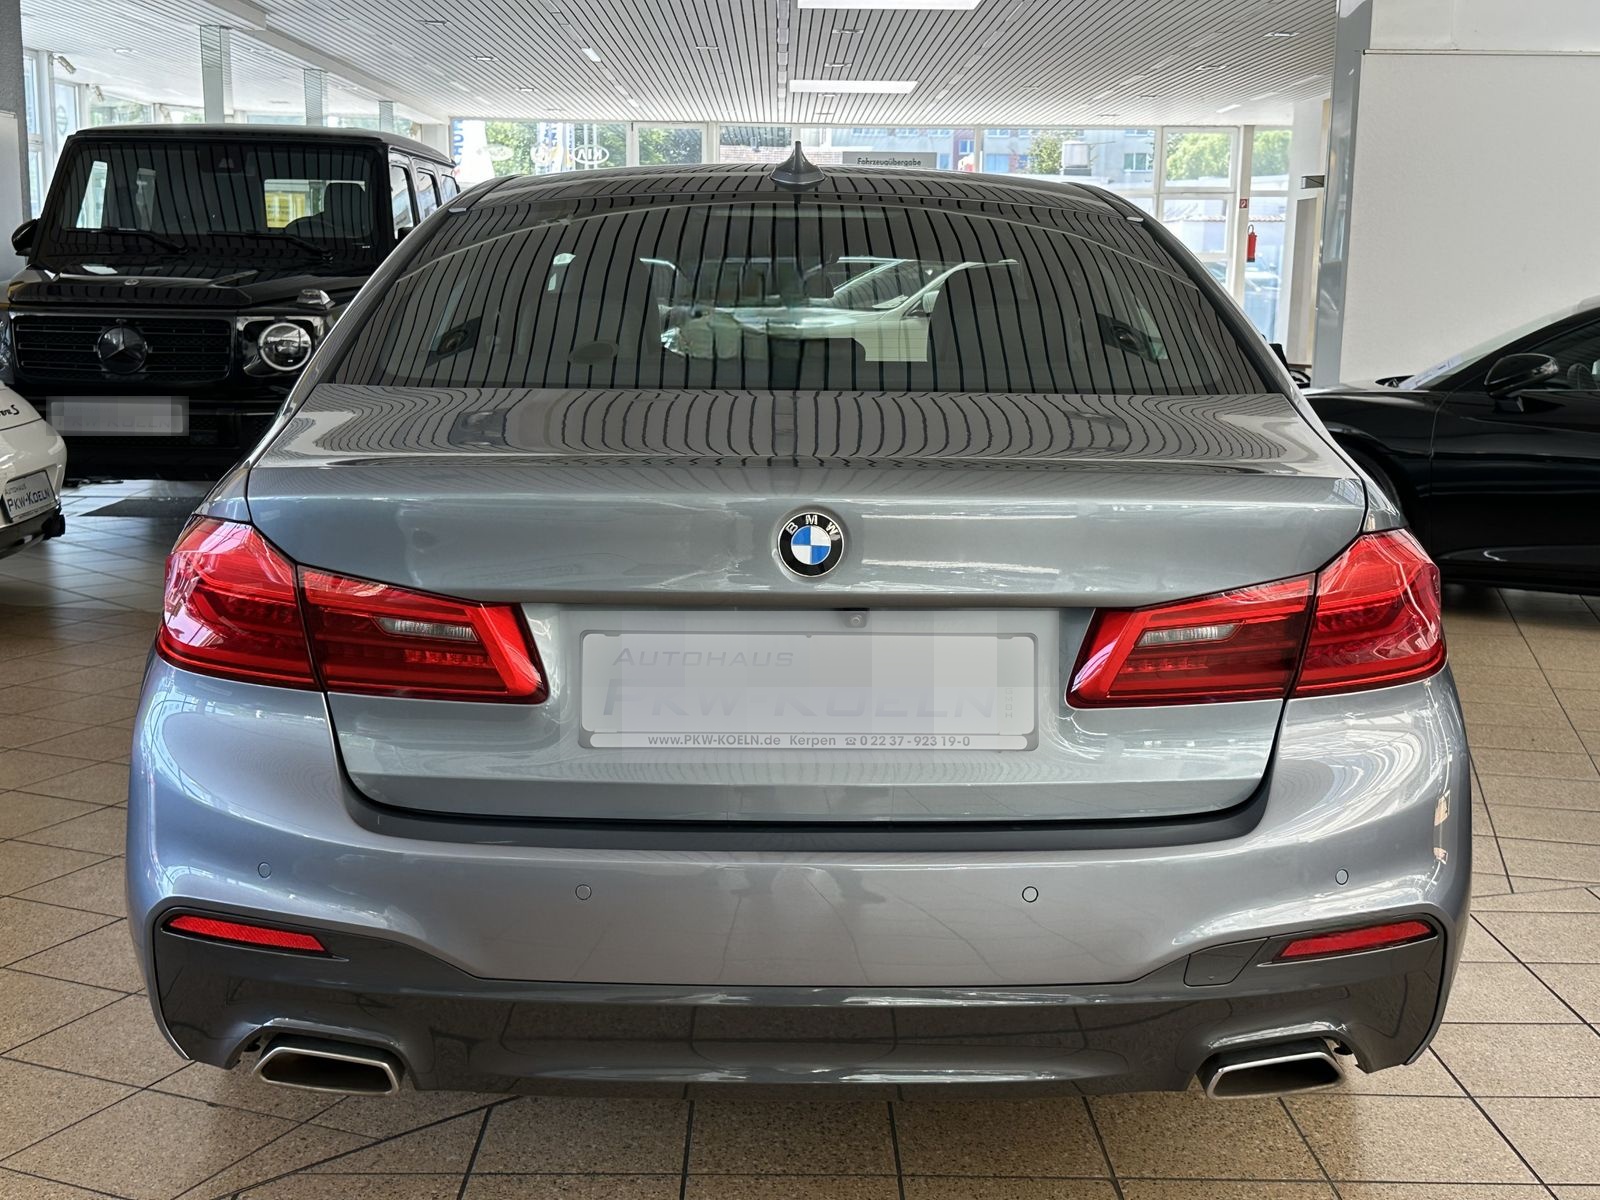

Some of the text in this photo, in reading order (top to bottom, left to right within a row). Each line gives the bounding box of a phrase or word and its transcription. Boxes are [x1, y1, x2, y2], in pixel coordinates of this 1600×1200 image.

[857, 157, 922, 167] Fahrzeugübergabe
[786, 514, 840, 541] BMW
[612, 647, 794, 668] AUTOHAUS
[648, 734, 781, 746] www.PKW-KOELN.de
[790, 735, 836, 748] Kerpen
